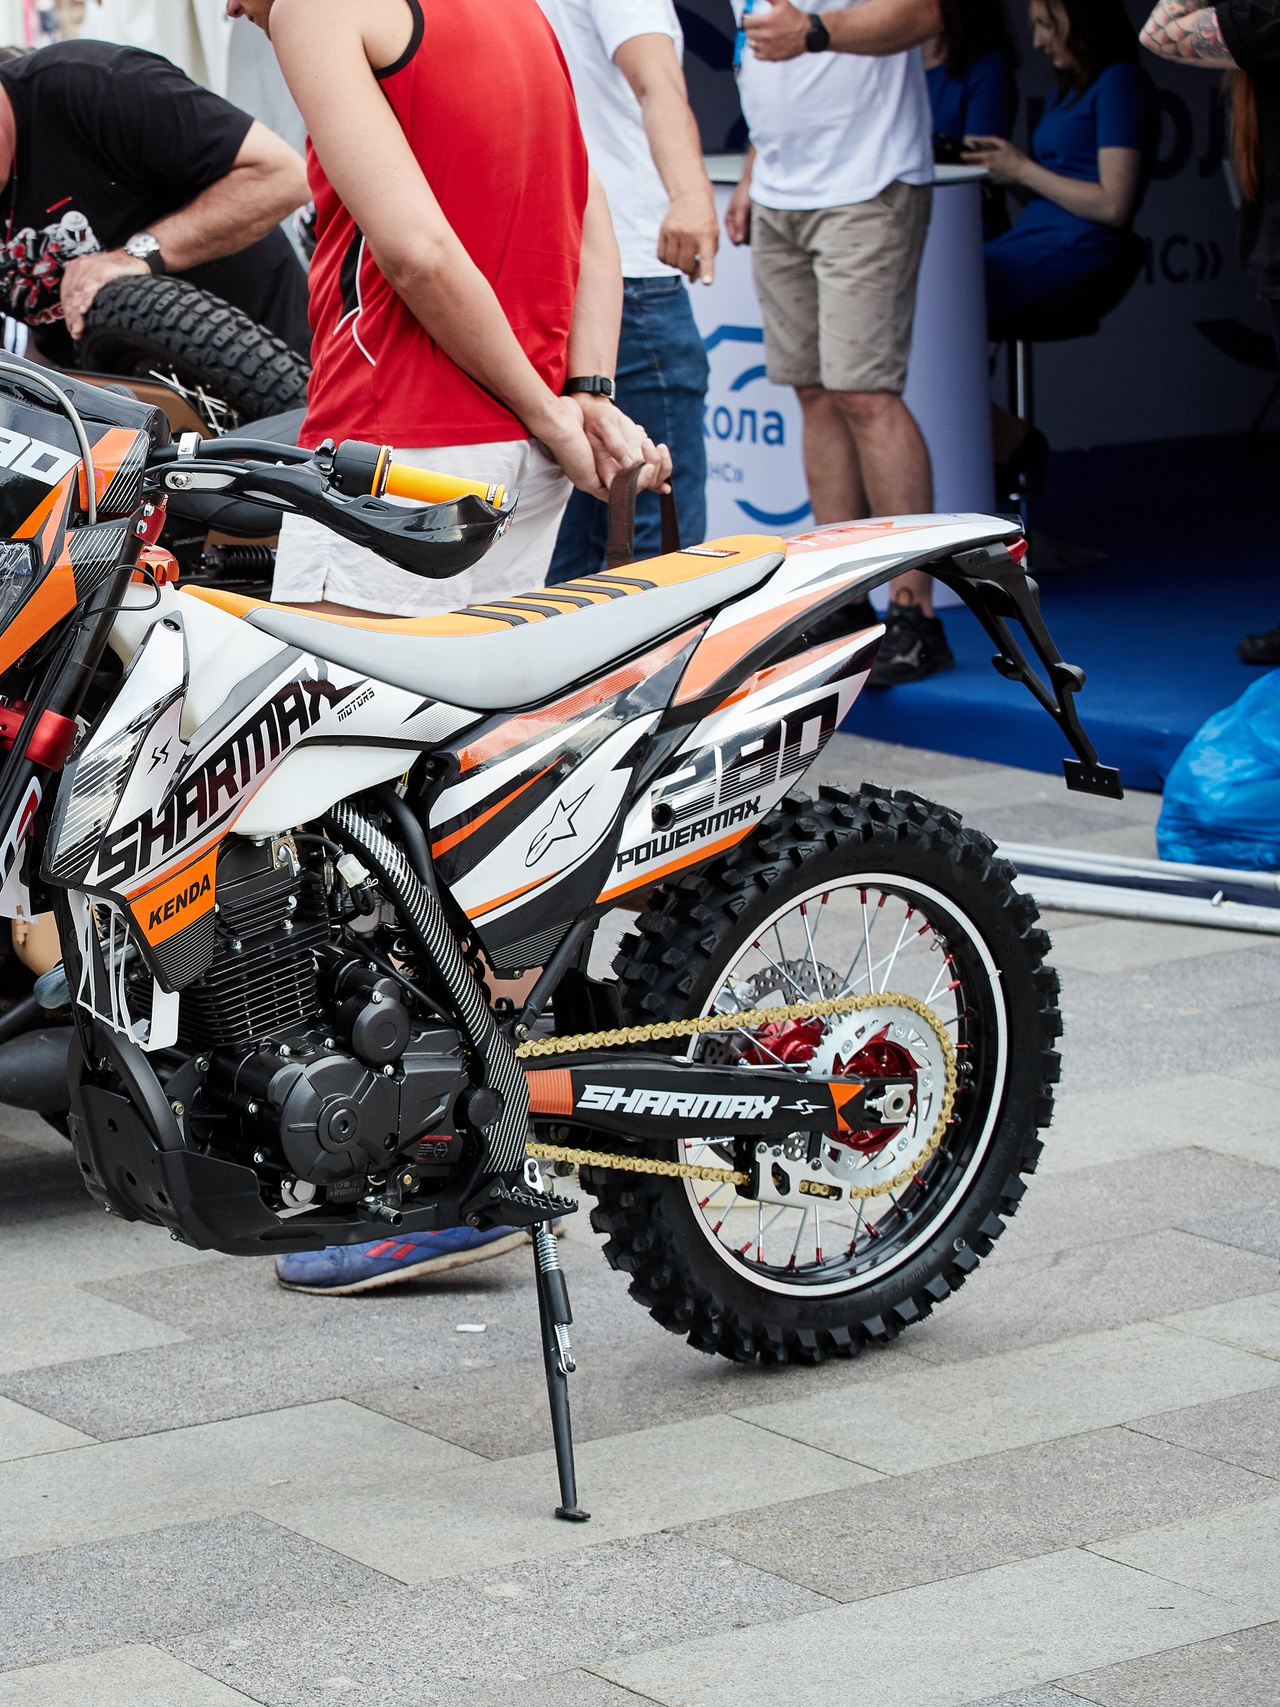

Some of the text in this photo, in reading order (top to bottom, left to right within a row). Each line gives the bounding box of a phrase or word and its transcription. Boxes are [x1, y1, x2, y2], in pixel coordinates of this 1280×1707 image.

[96, 657, 376, 890] SHARMAX MOTORS
[650, 691, 840, 834] 280
[615, 795, 768, 874] POWERMAX
[148, 873, 212, 931] KENDA
[575, 1083, 781, 1120] SHARMAX
